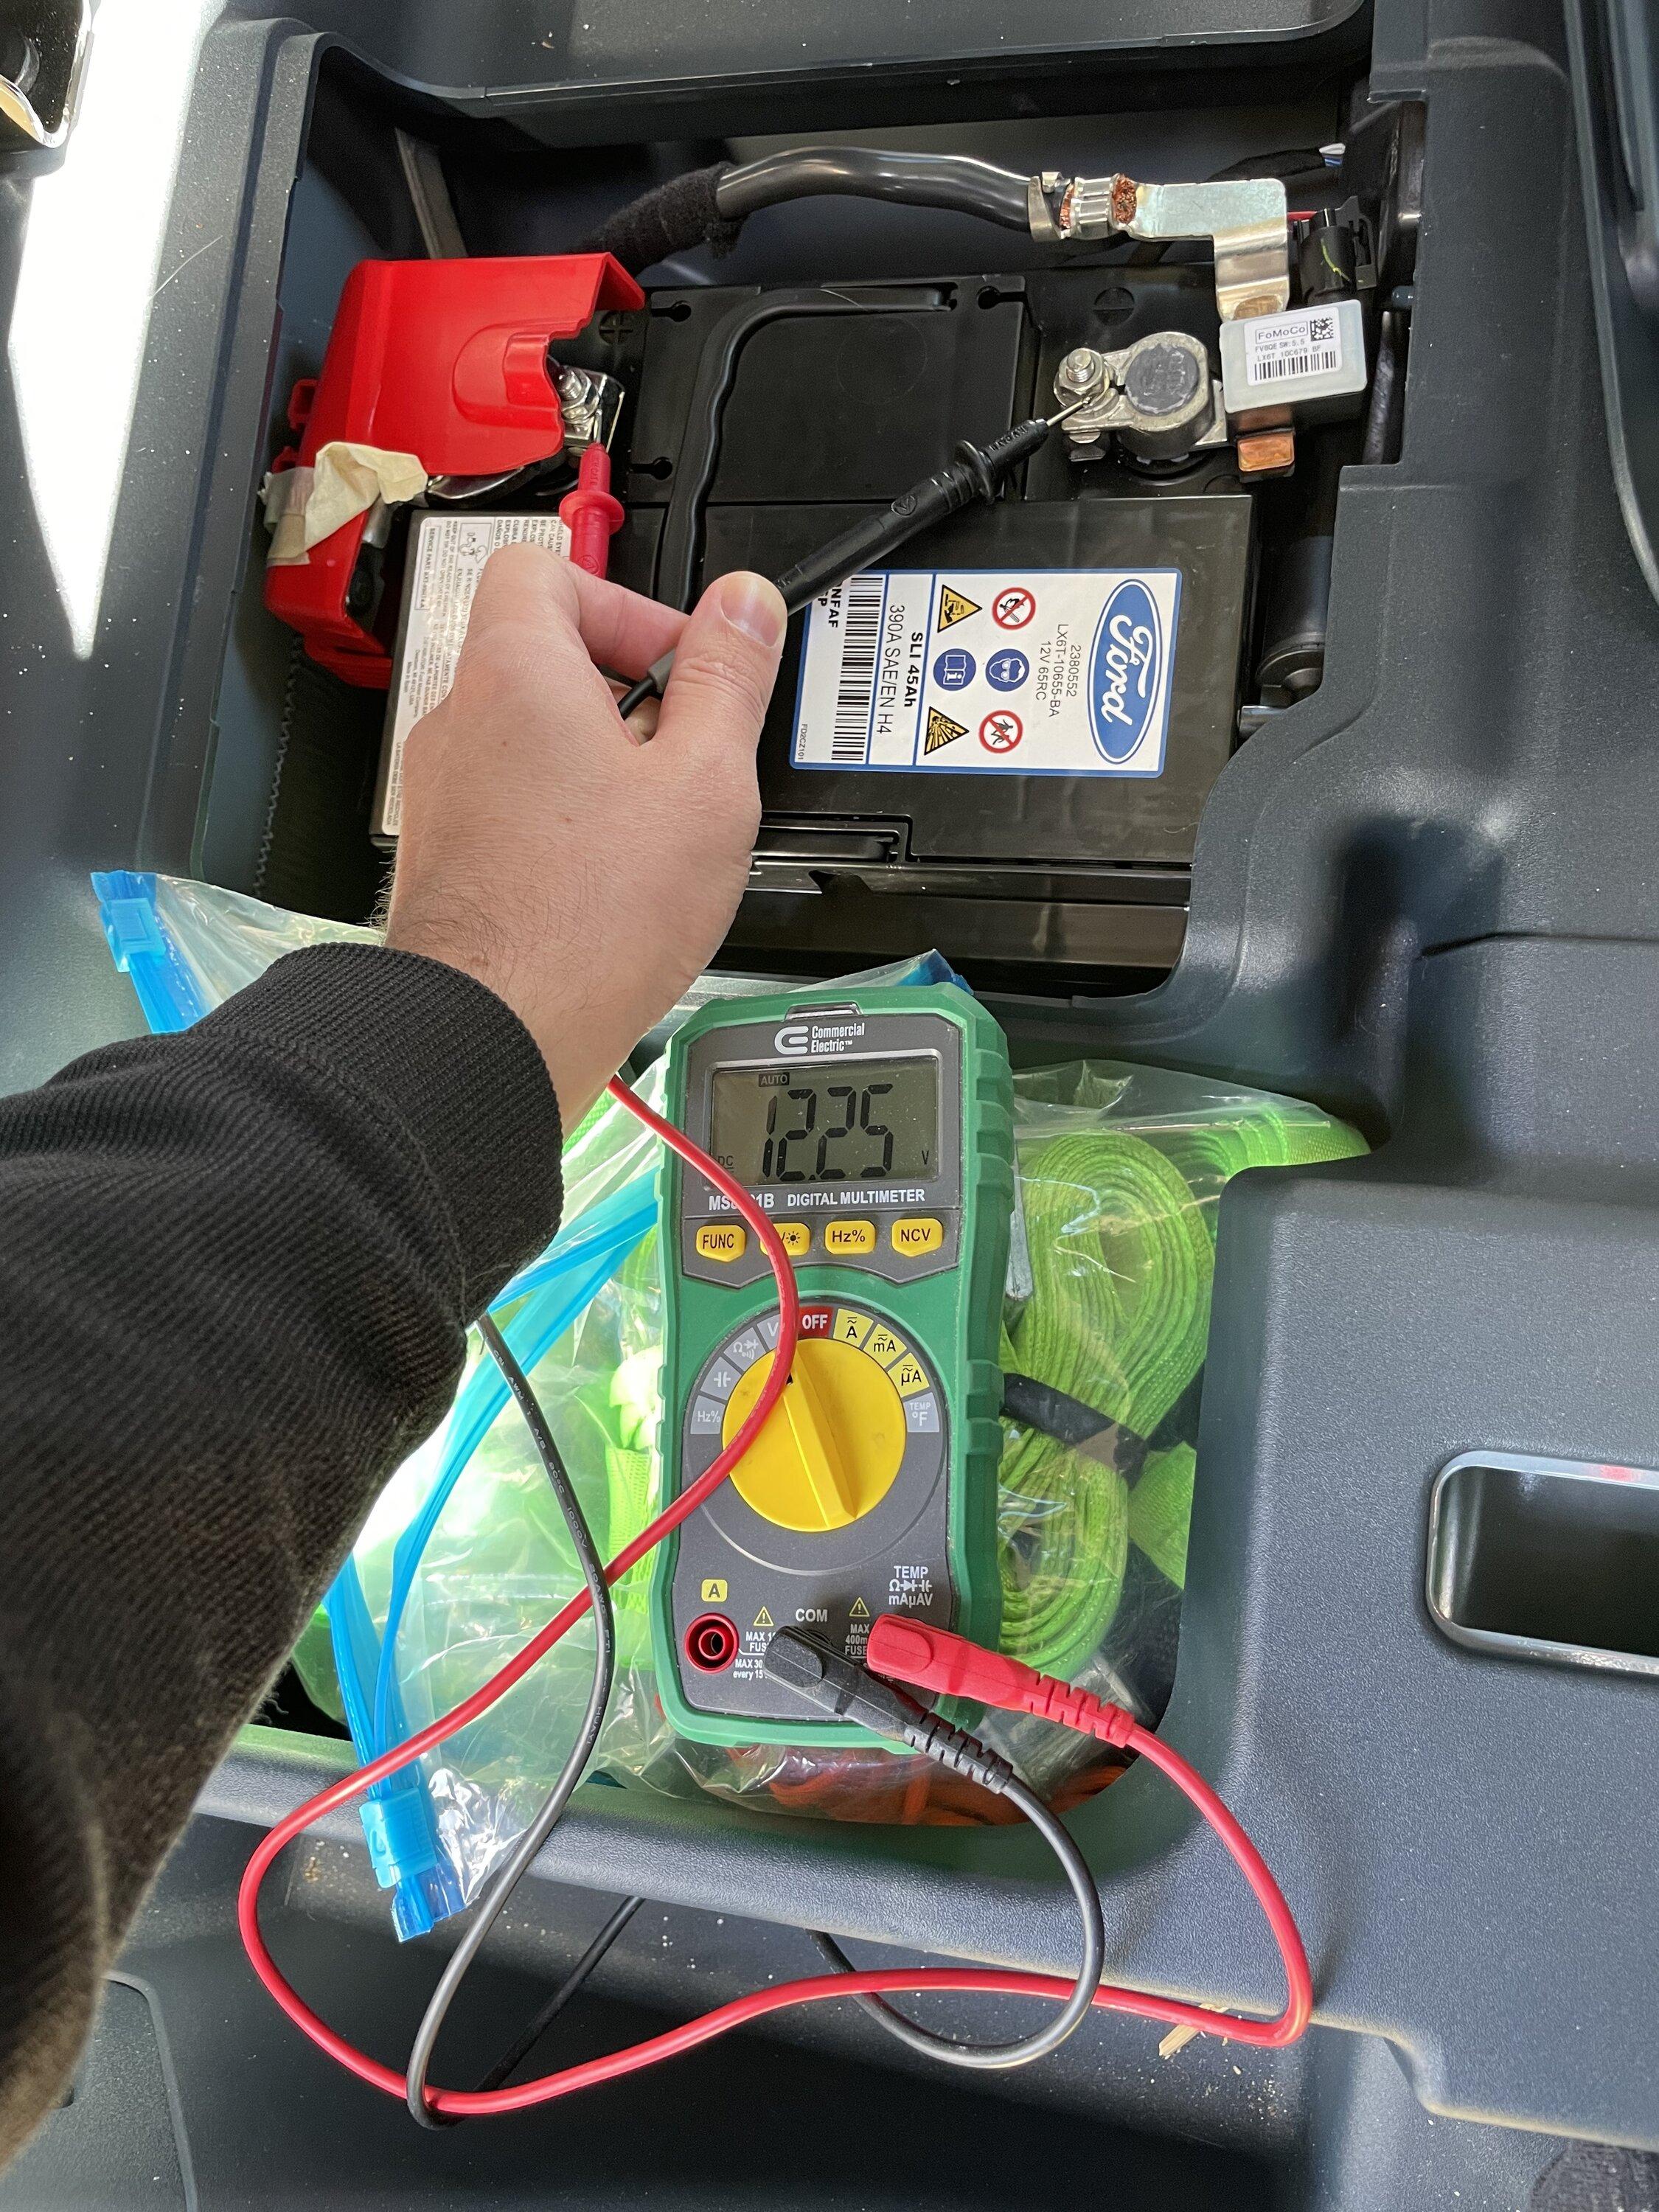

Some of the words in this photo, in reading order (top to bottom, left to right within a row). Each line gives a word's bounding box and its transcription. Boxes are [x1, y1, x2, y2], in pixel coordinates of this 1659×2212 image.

[1258, 326, 1306, 340] FoMoCo
[886, 605, 905, 644] 390A
[909, 632, 923, 658] SLI
[1040, 641, 1051, 662] 12V
[879, 647, 901, 708] SAE/EN
[1048, 624, 1069, 717] LX6T-10655-BA
[1065, 645, 1082, 697] 2380552
[1102, 614, 1153, 726] Ford
[904, 664, 920, 707] 45Ah
[1035, 667, 1049, 700] 65RC
[877, 714, 894, 734] H4
[811, 1023, 865, 1038] Commercial
[760, 1074, 789, 1086] AUTO
[921, 1150, 929, 1165] V
[709, 1193, 774, 1211] MS1B
[787, 1192, 838, 1208] DIGITAL
[840, 1189, 925, 1205] MULTIMETER
[702, 1234, 735, 1250] FUNC
[832, 1230, 866, 1244] Hz%
[900, 1228, 931, 1242] NCV
[801, 1314, 828, 1330] OFF
[873, 1339, 897, 1352] mA
[909, 1402, 931, 1411] TEMP
[697, 1410, 721, 1424] Hz%
[508, 1376, 524, 1400] AWM
[566, 1506, 588, 1548] 1000V
[894, 1565, 929, 1579] TEMP
[708, 1582, 720, 1598] A
[796, 1608, 828, 1623] COM
[745, 1631, 765, 1642] MAX
[850, 1624, 870, 1634] MAX
[749, 1642, 769, 1652] FUS
[845, 1634, 868, 1645] 400m
[735, 1658, 753, 1669] MAX
[733, 1671, 754, 1681] every
[755, 1669, 763, 1679] 15
